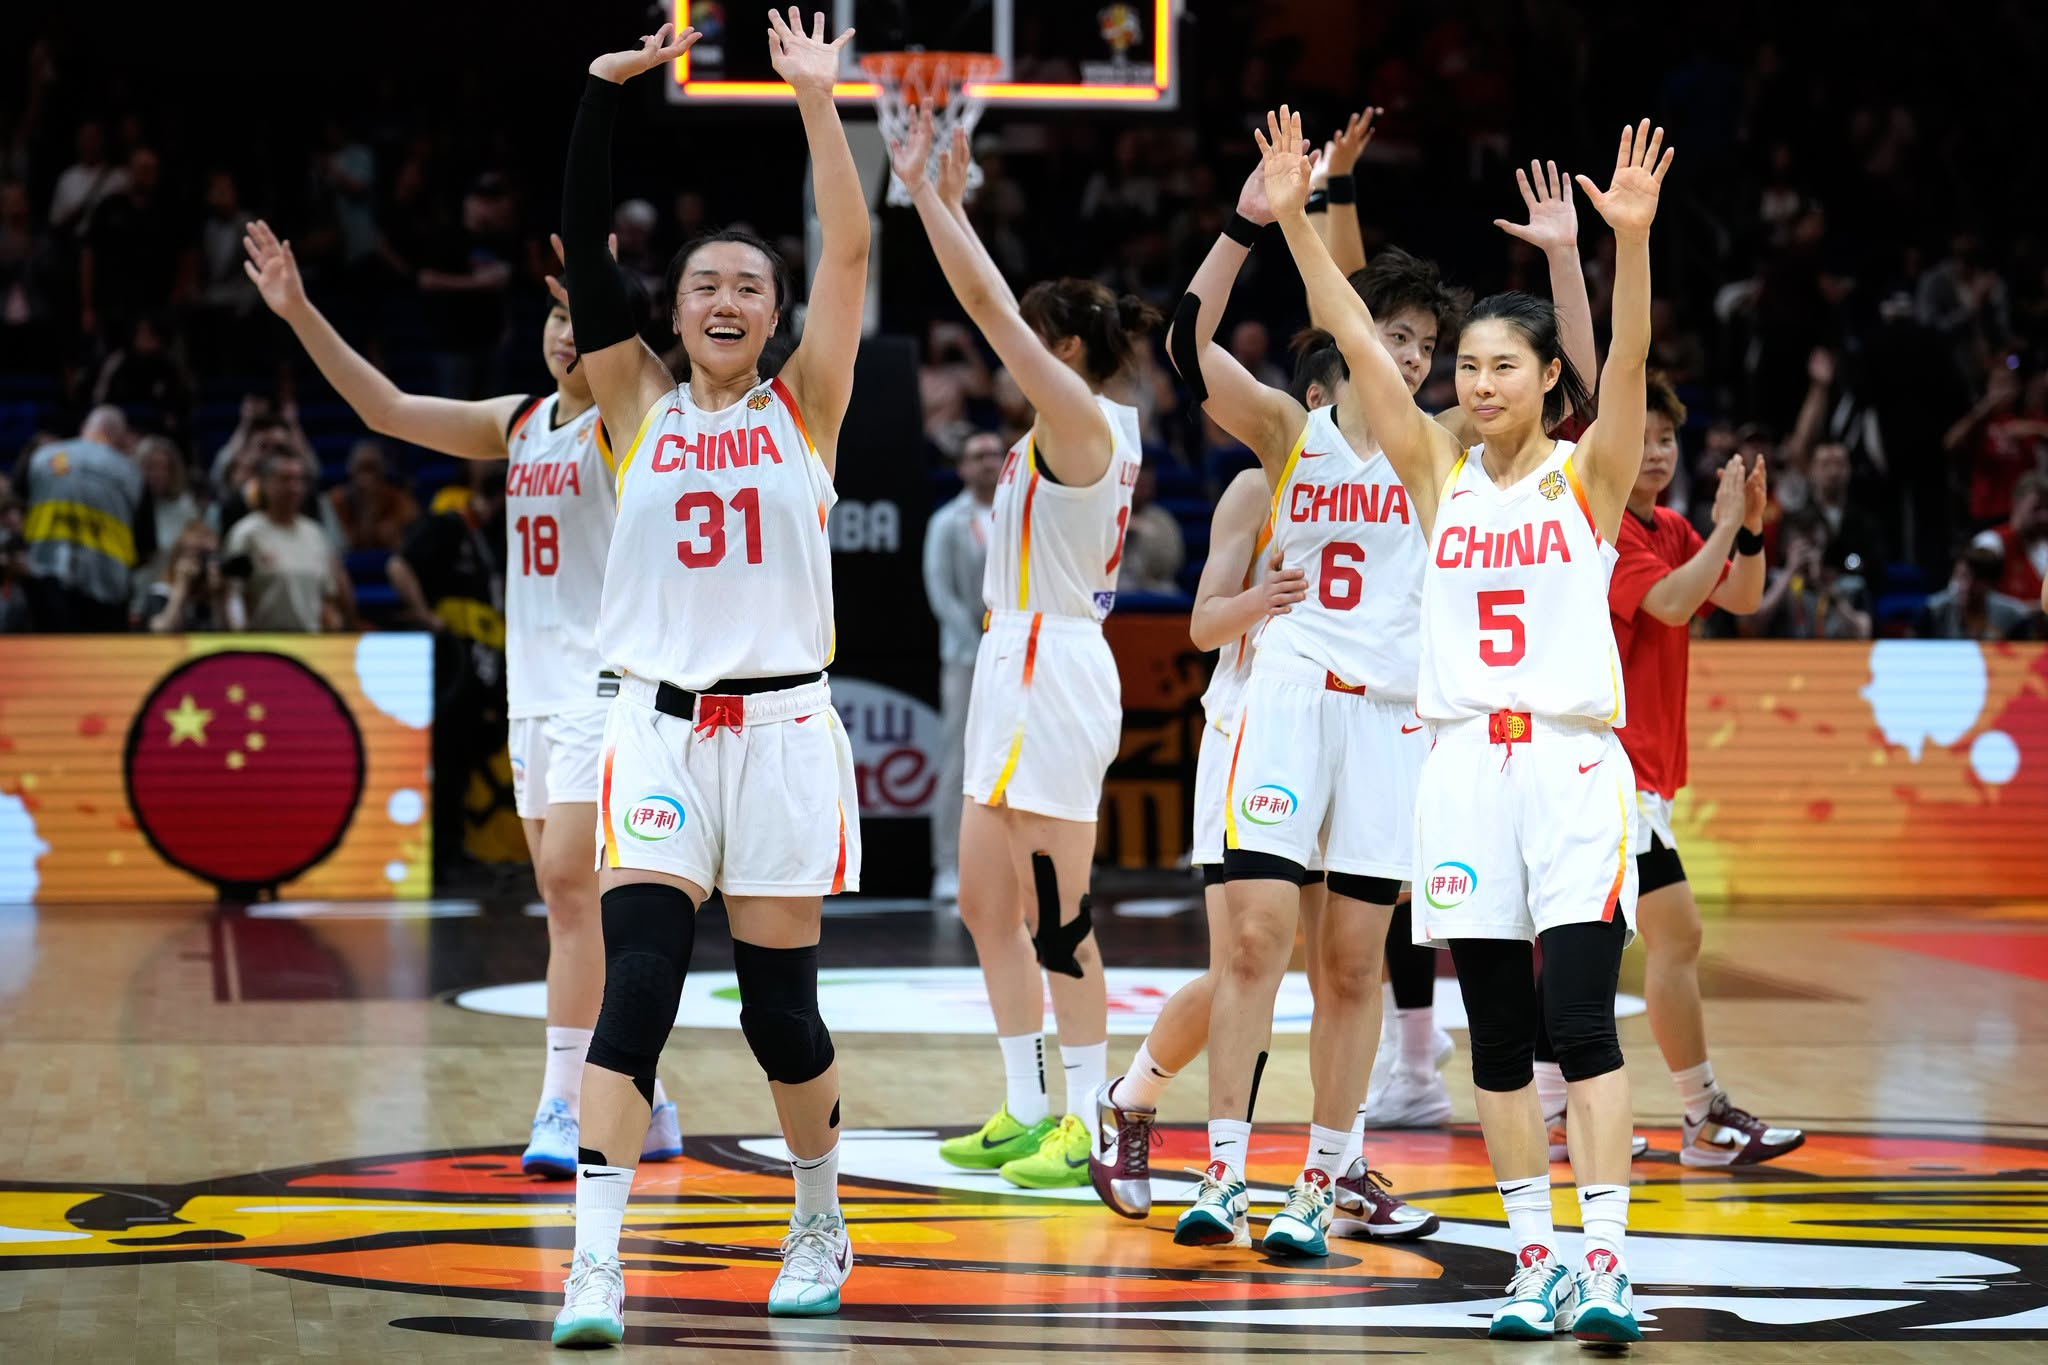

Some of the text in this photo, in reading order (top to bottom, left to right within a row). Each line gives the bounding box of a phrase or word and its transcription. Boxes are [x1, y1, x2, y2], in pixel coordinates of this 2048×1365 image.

[651, 425, 783, 473] CHINA
[505, 461, 581, 497] CHINA
[675, 487, 763, 569] 31
[1290, 483, 1410, 525] CHINA
[515, 515, 559, 576] 18
[1435, 520, 1572, 569] CHINA
[1318, 541, 1366, 612] 6
[1476, 589, 1526, 668] 5
[631, 807, 677, 830] 伊利
[1248, 794, 1290, 816] 伊利
[1431, 875, 1468, 895] 伊利
